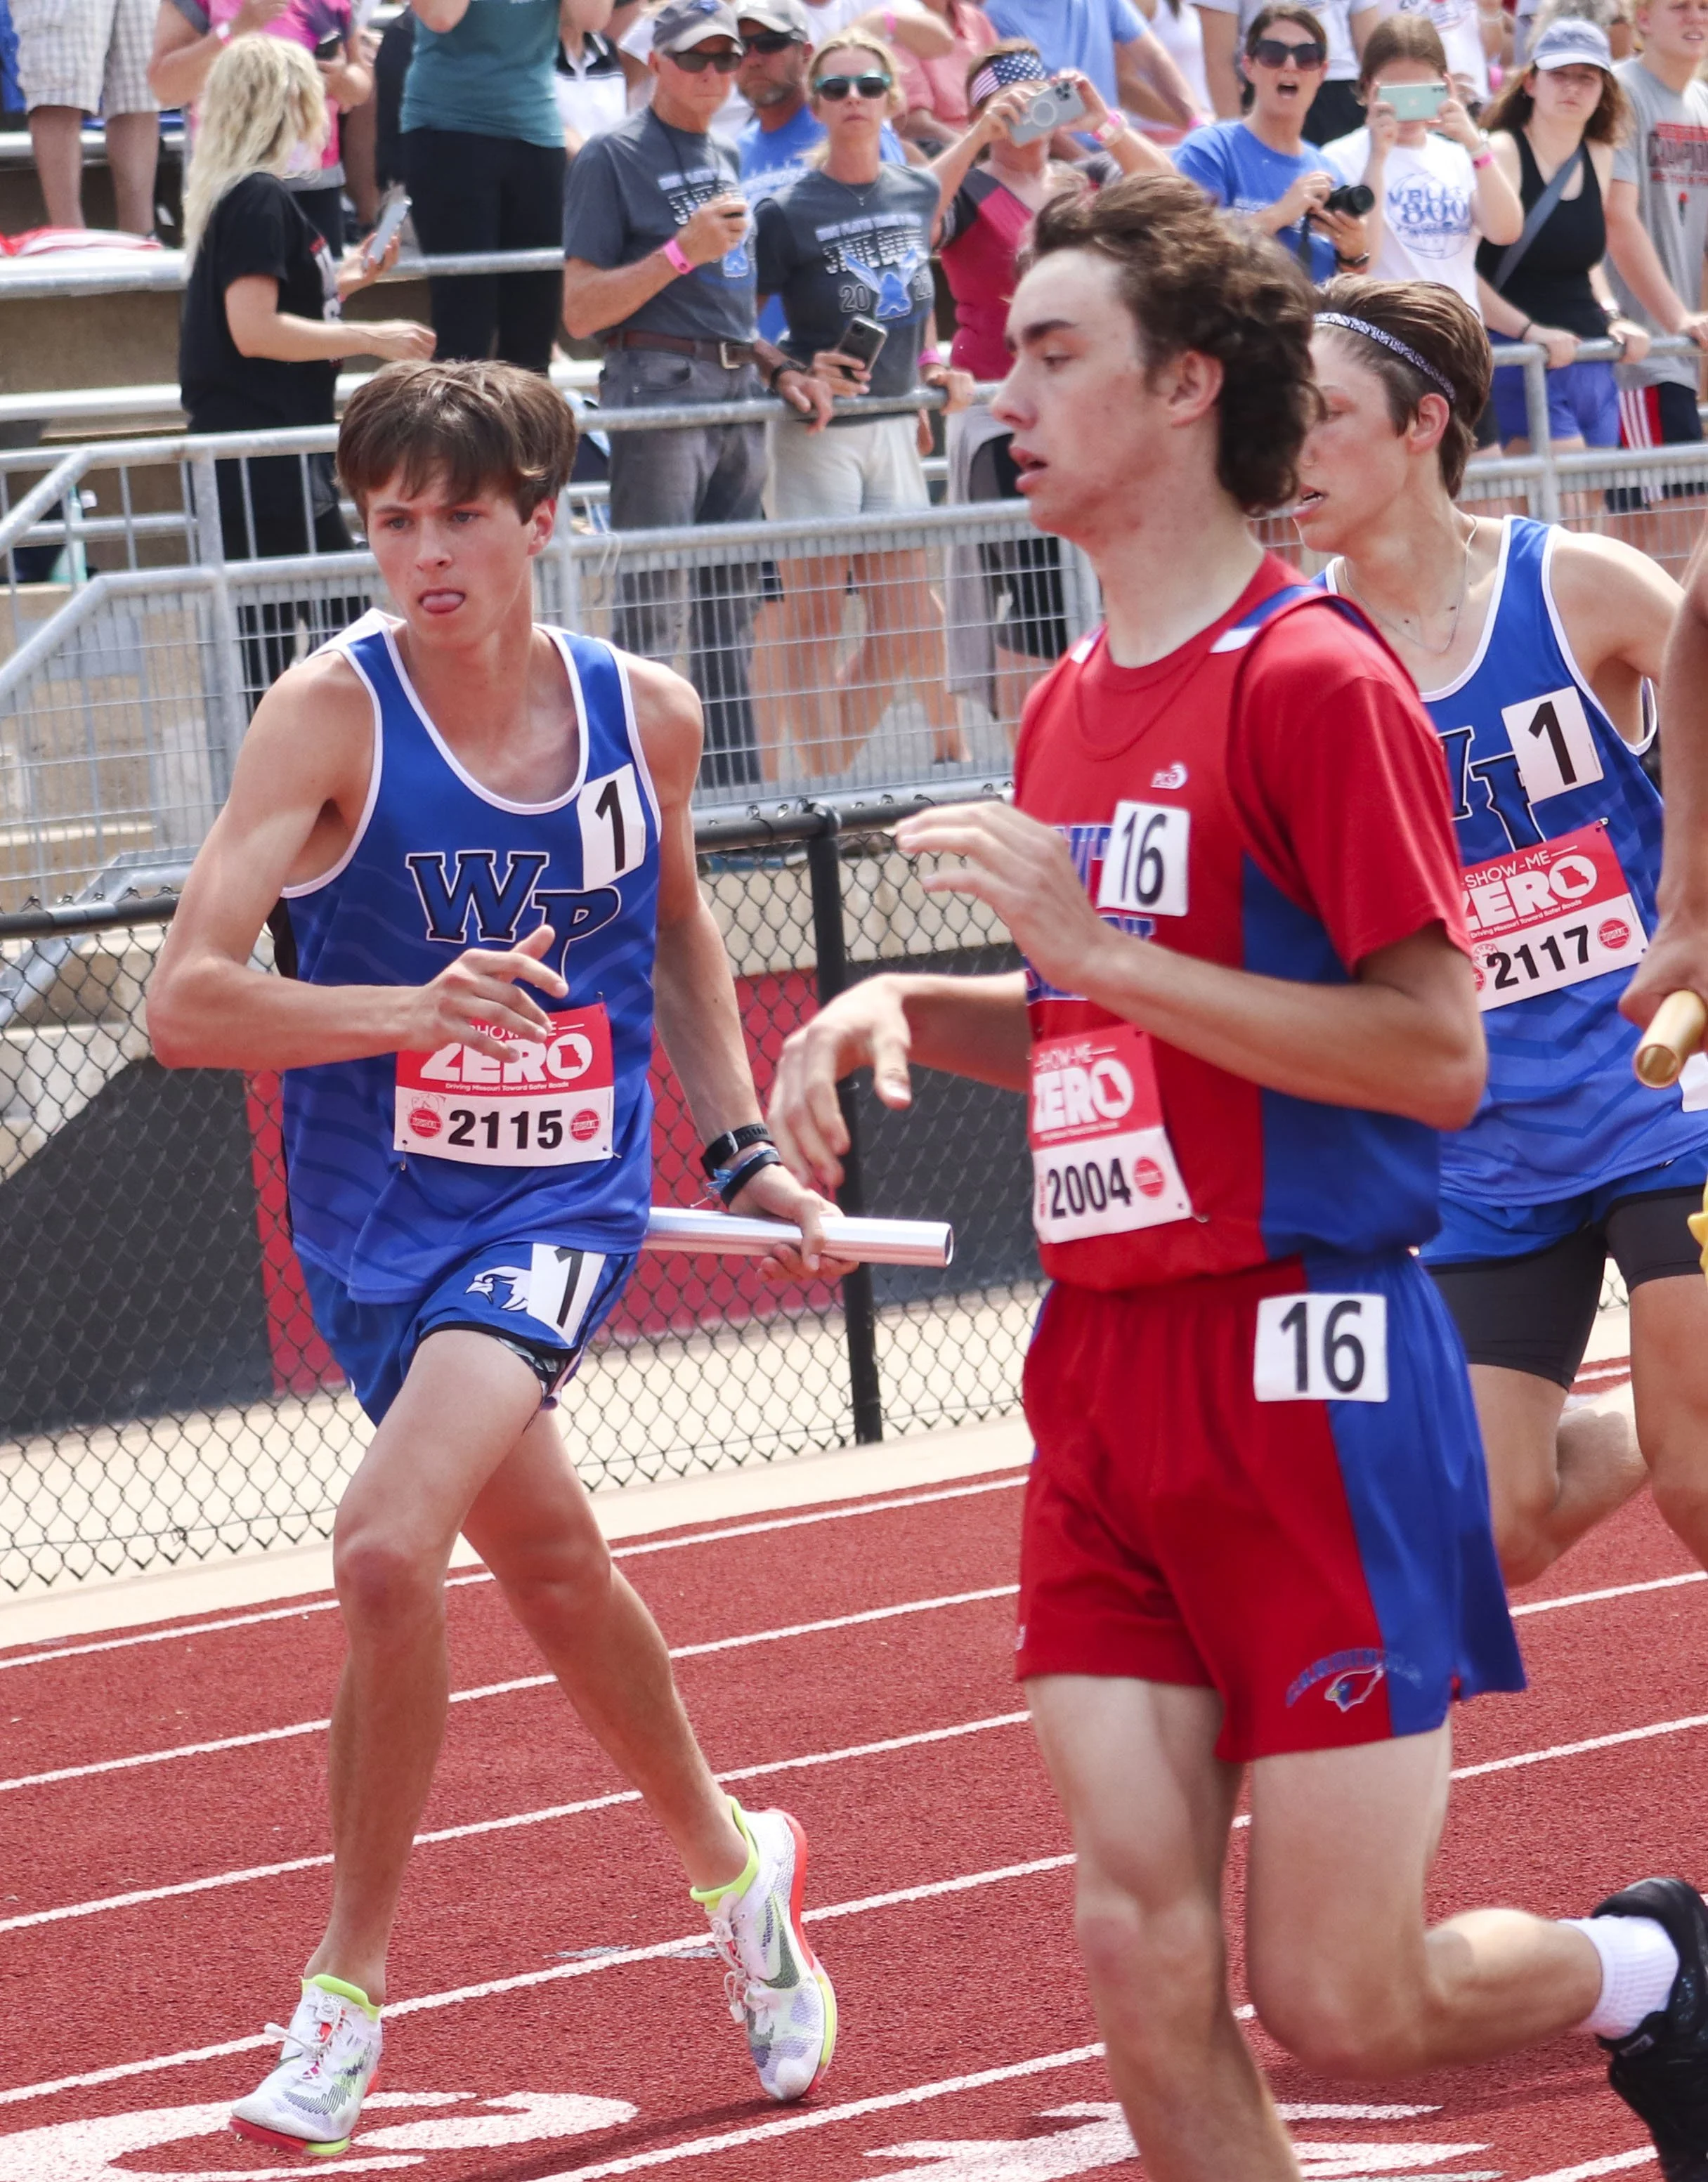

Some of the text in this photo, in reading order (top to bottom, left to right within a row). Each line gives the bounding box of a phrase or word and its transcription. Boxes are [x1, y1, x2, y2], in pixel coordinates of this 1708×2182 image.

[839, 284, 871, 313] 20
[1528, 701, 1577, 786] 1
[595, 779, 625, 874] 1
[1123, 811, 1167, 908] 16
[1464, 850, 1551, 889] SHOW-ME
[1494, 920, 1519, 932] Missouri
[1487, 925, 1589, 990] 2117
[420, 1032, 593, 1081] ZERO
[445, 1083, 471, 1091] Driving
[471, 1083, 501, 1092] Missouri
[448, 1109, 563, 1150] 2115
[1048, 1158, 1133, 1220] 2004
[554, 1247, 585, 1329] 1
[1280, 1299, 1365, 1393] 16
